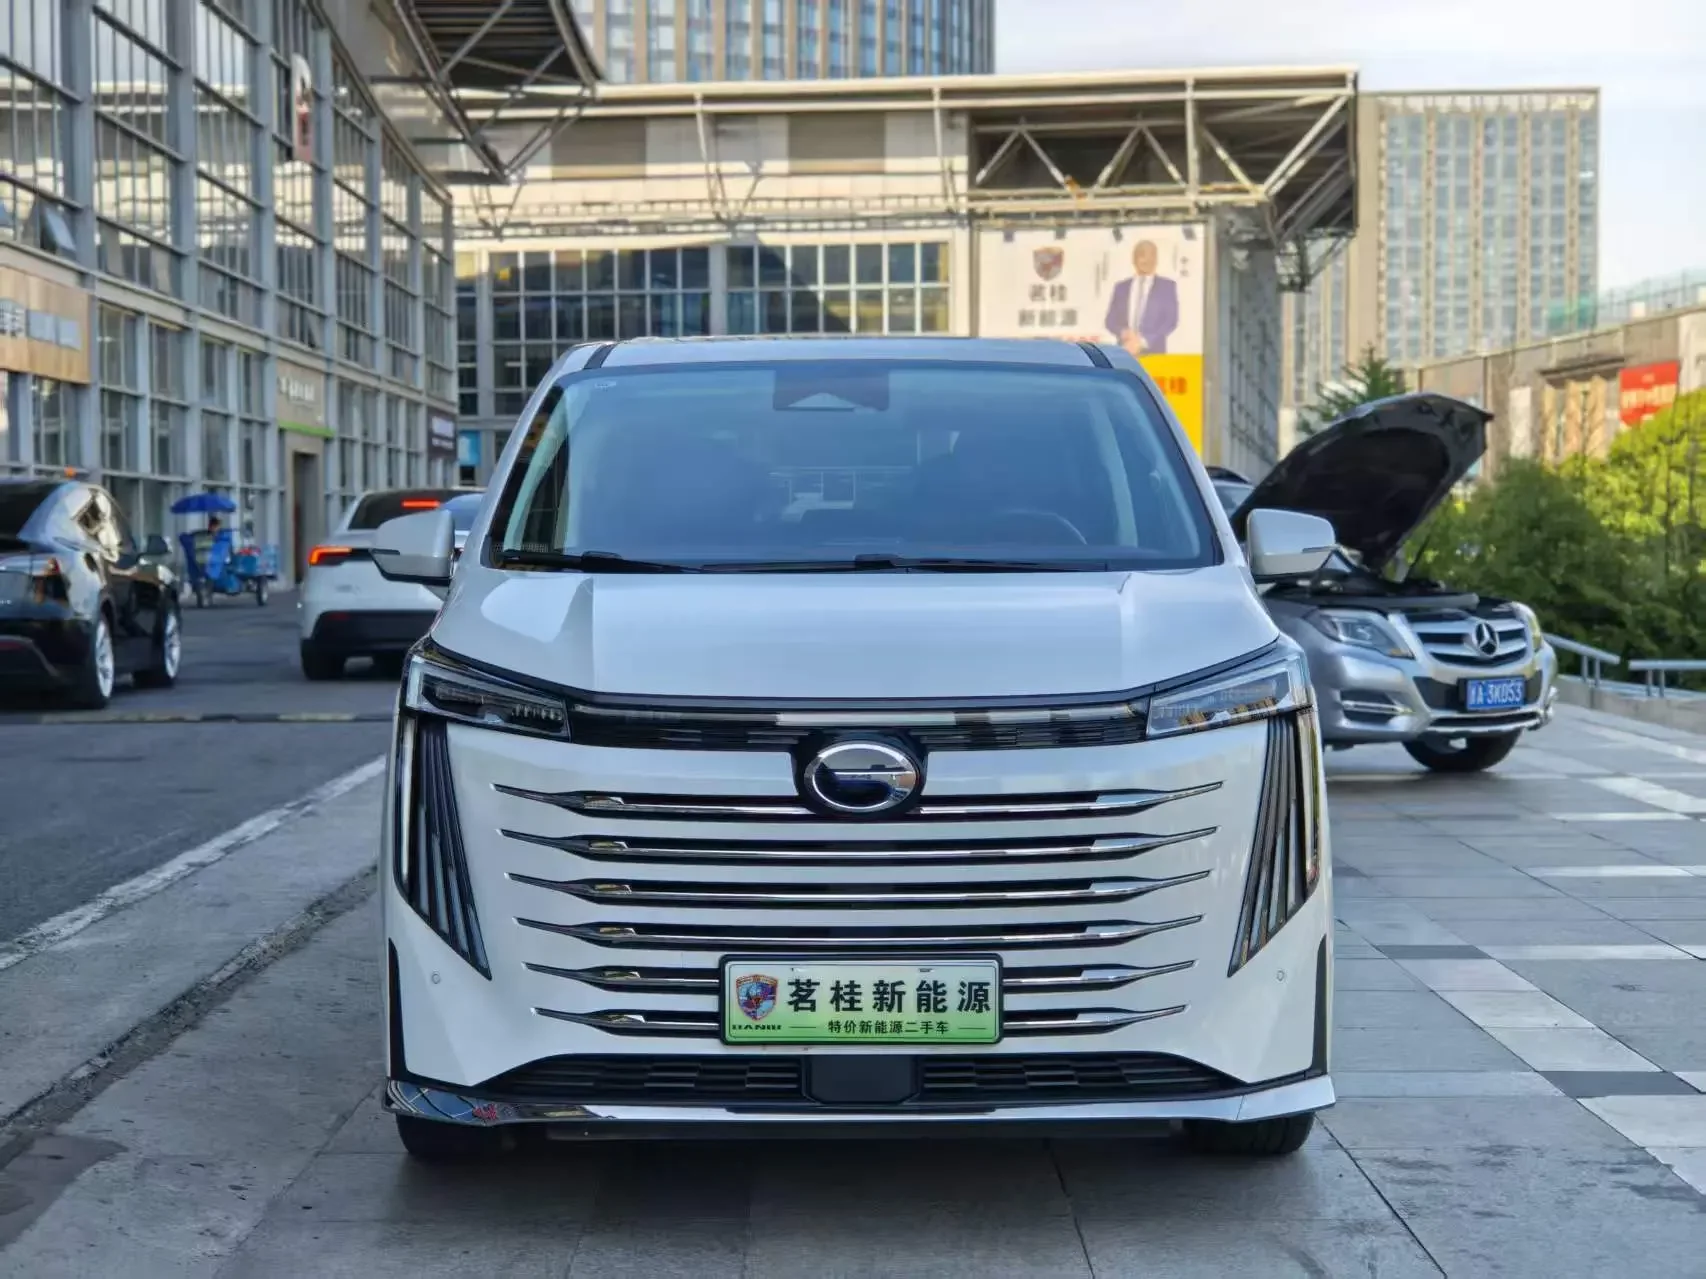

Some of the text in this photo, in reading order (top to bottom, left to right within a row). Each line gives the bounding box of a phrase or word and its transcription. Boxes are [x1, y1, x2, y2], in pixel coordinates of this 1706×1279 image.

[787, 978, 991, 1014] 茗桂新能源
[828, 1020, 950, 1035] 特价新能源二手车
